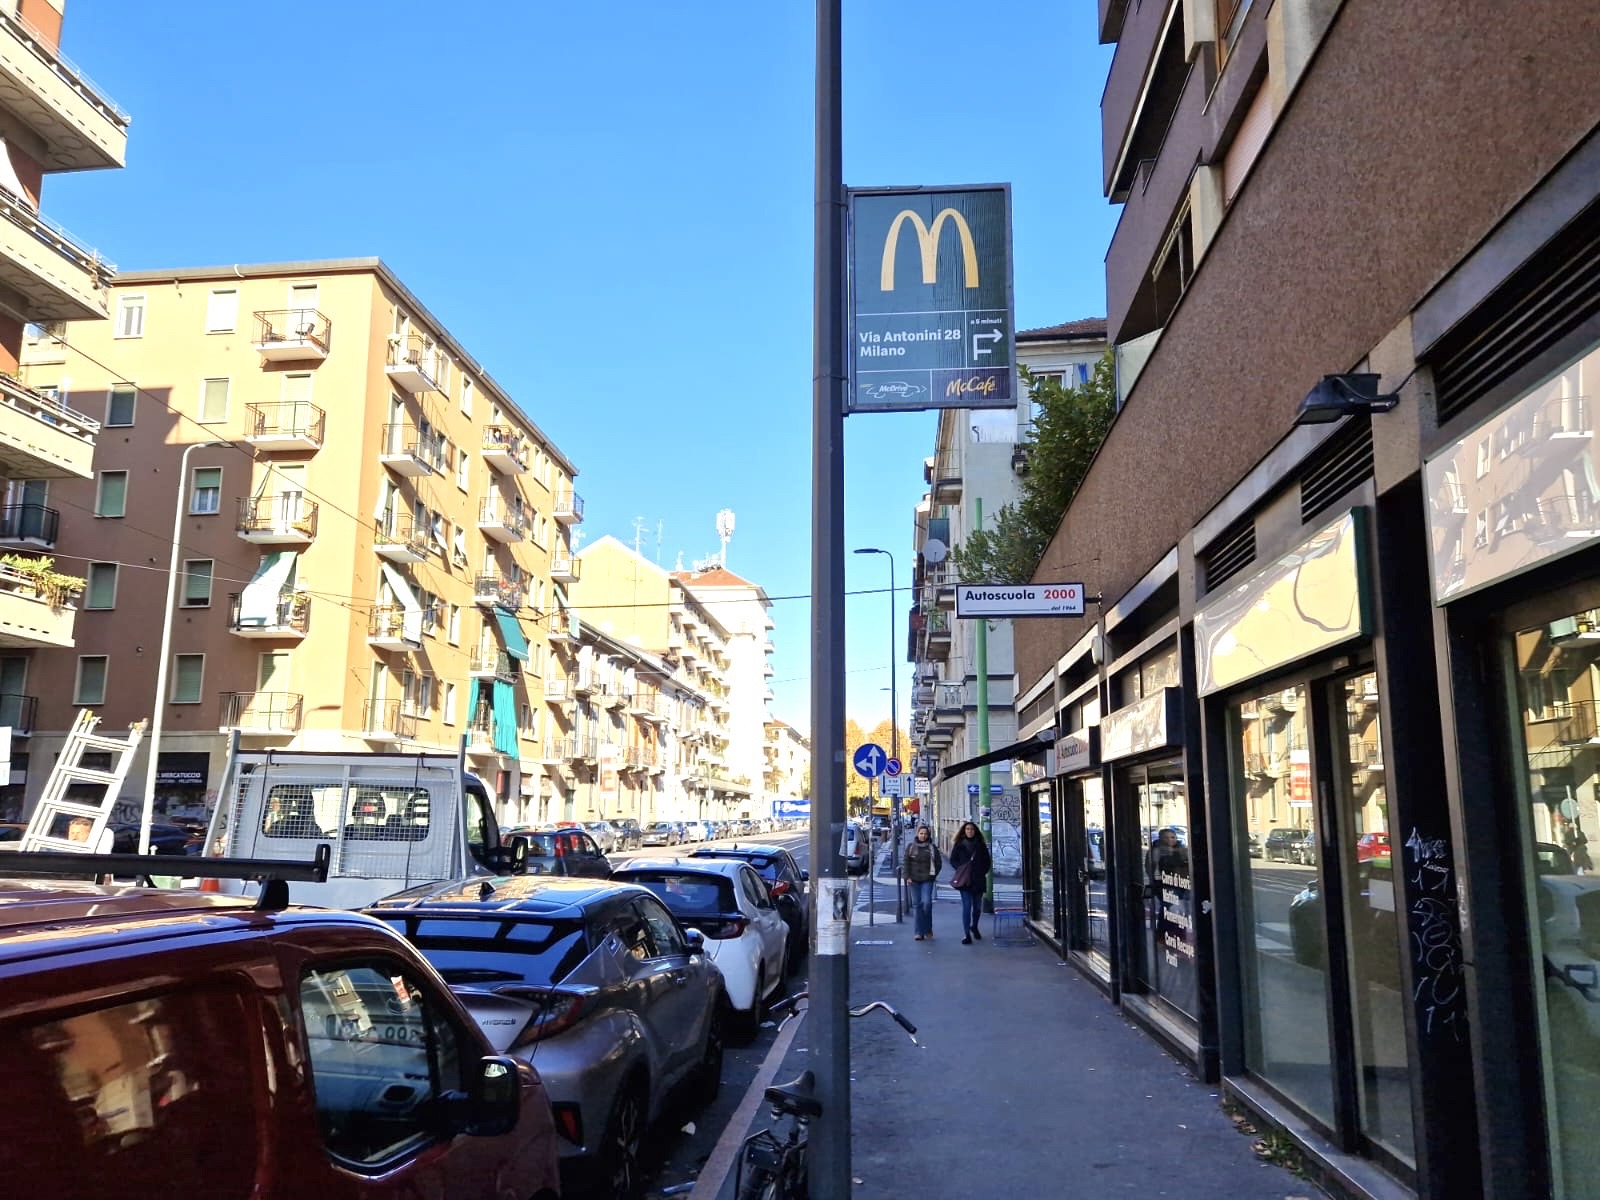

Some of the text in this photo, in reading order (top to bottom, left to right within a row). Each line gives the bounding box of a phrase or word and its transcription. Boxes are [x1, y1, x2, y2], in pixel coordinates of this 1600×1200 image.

[981, 317, 1002, 325] minuti
[859, 329, 961, 343] Via Antonini 28
[860, 345, 906, 357] Milano
[879, 384, 909, 393] McDrive
[965, 588, 1076, 602] Autoscuola 2000
[1164, 931, 1176, 949] Corsi
